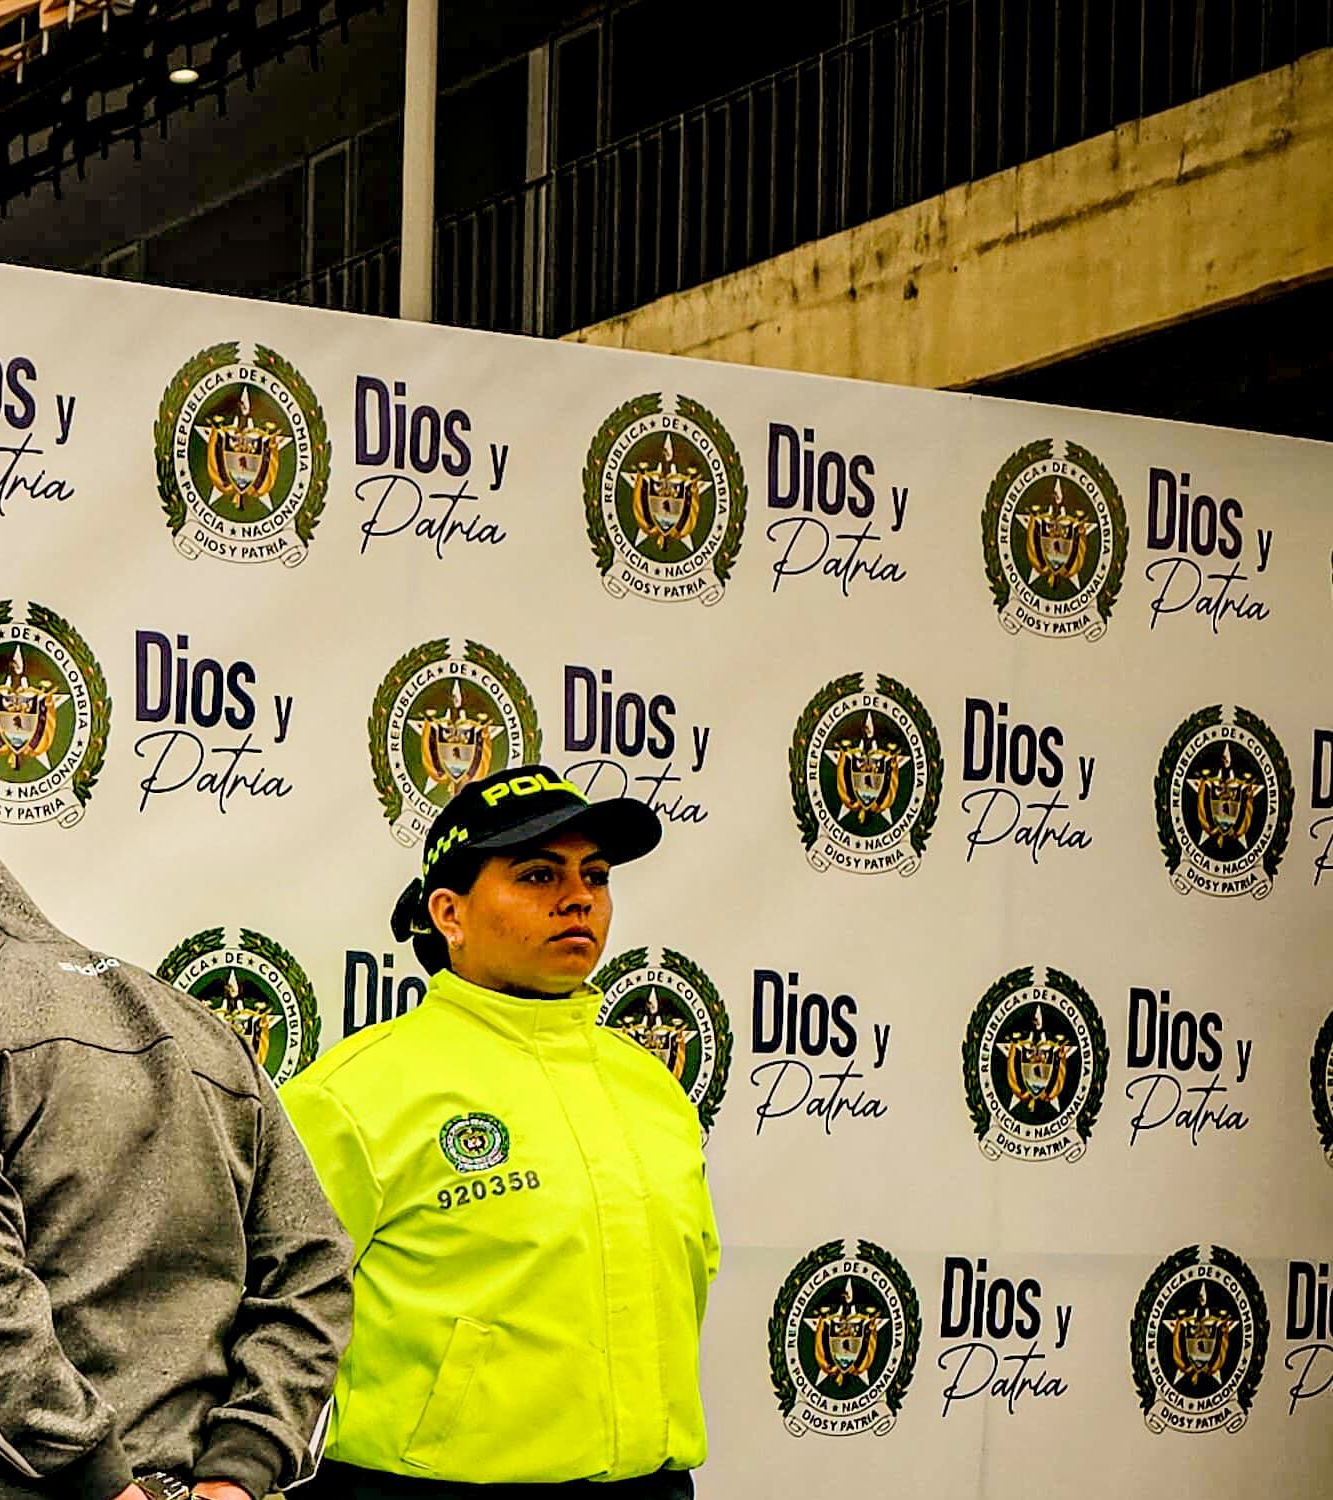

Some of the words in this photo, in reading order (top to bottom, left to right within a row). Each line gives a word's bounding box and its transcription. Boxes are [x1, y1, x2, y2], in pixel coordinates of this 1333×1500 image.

[56, 395, 75, 444] y
[355, 375, 471, 476] Dios
[490, 444, 508, 490] y
[355, 475, 506, 559] Patria
[768, 423, 874, 518] Dios
[891, 487, 908, 531] y
[767, 517, 906, 597] Patria
[1147, 468, 1243, 559] Dios
[1257, 529, 1272, 572] y
[10, 628, 31, 641] DE
[1146, 558, 1269, 634] Patria
[136, 630, 255, 730] Dios
[274, 696, 292, 743] y
[565, 665, 675, 759] Dios
[692, 726, 709, 772] y
[135, 731, 292, 814] Patria
[963, 698, 1063, 787] Dios
[1079, 757, 1094, 800] y
[962, 789, 1092, 864] Patria
[224, 954, 244, 966] DE
[258, 964, 300, 1046] COLOMBIA
[343, 950, 427, 1038] Dio
[752, 970, 857, 1057] Dios
[874, 1024, 890, 1068] y
[1128, 988, 1222, 1071] Dios
[1237, 1040, 1252, 1082] y
[751, 1060, 887, 1135] Patria
[1126, 1074, 1249, 1146] Patria
[437, 1170, 540, 1210] 920358
[842, 1263, 860, 1274] DE
[941, 1257, 1041, 1339] Dios
[1056, 1306, 1071, 1348] y
[938, 1341, 1068, 1417] Patria
